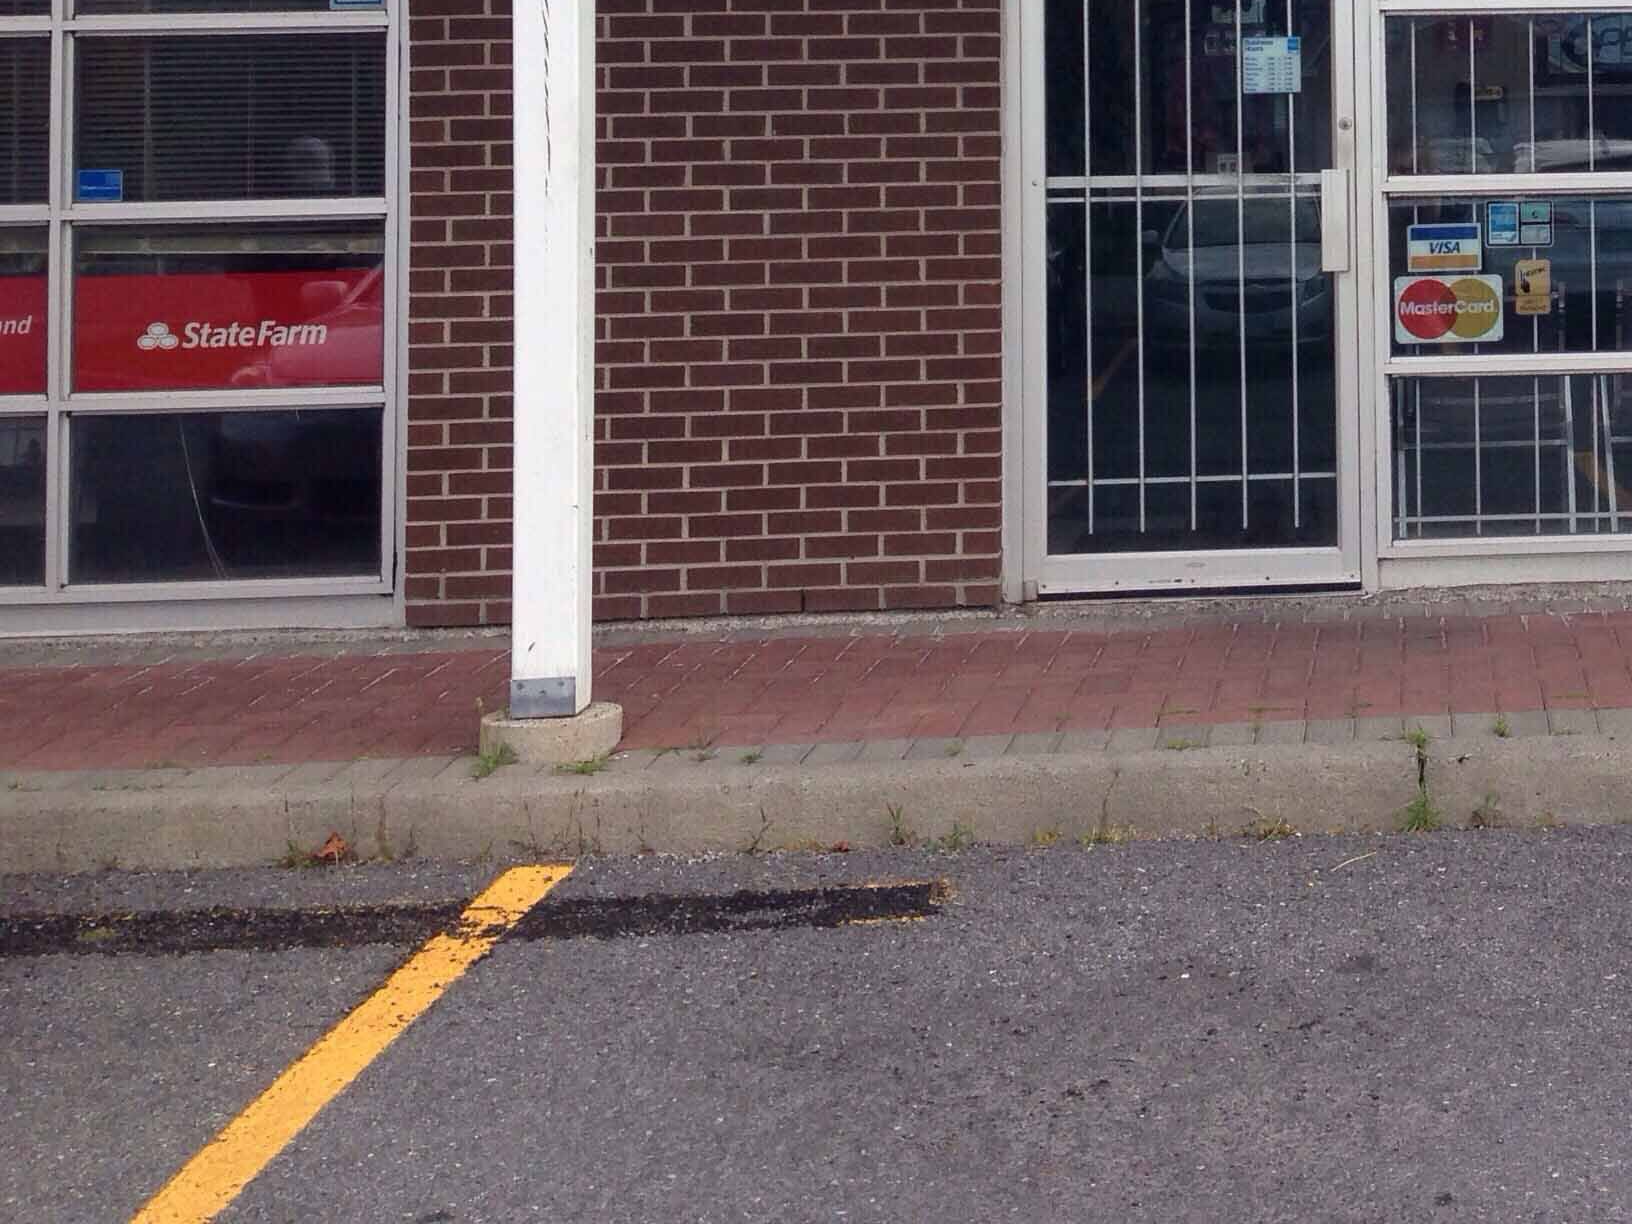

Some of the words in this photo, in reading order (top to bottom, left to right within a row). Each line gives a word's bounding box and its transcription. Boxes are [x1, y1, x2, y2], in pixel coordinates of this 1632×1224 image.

[1429, 241, 1462, 254] VISA
[1400, 299, 1496, 316] MasterCard
[0, 314, 33, 335] nd
